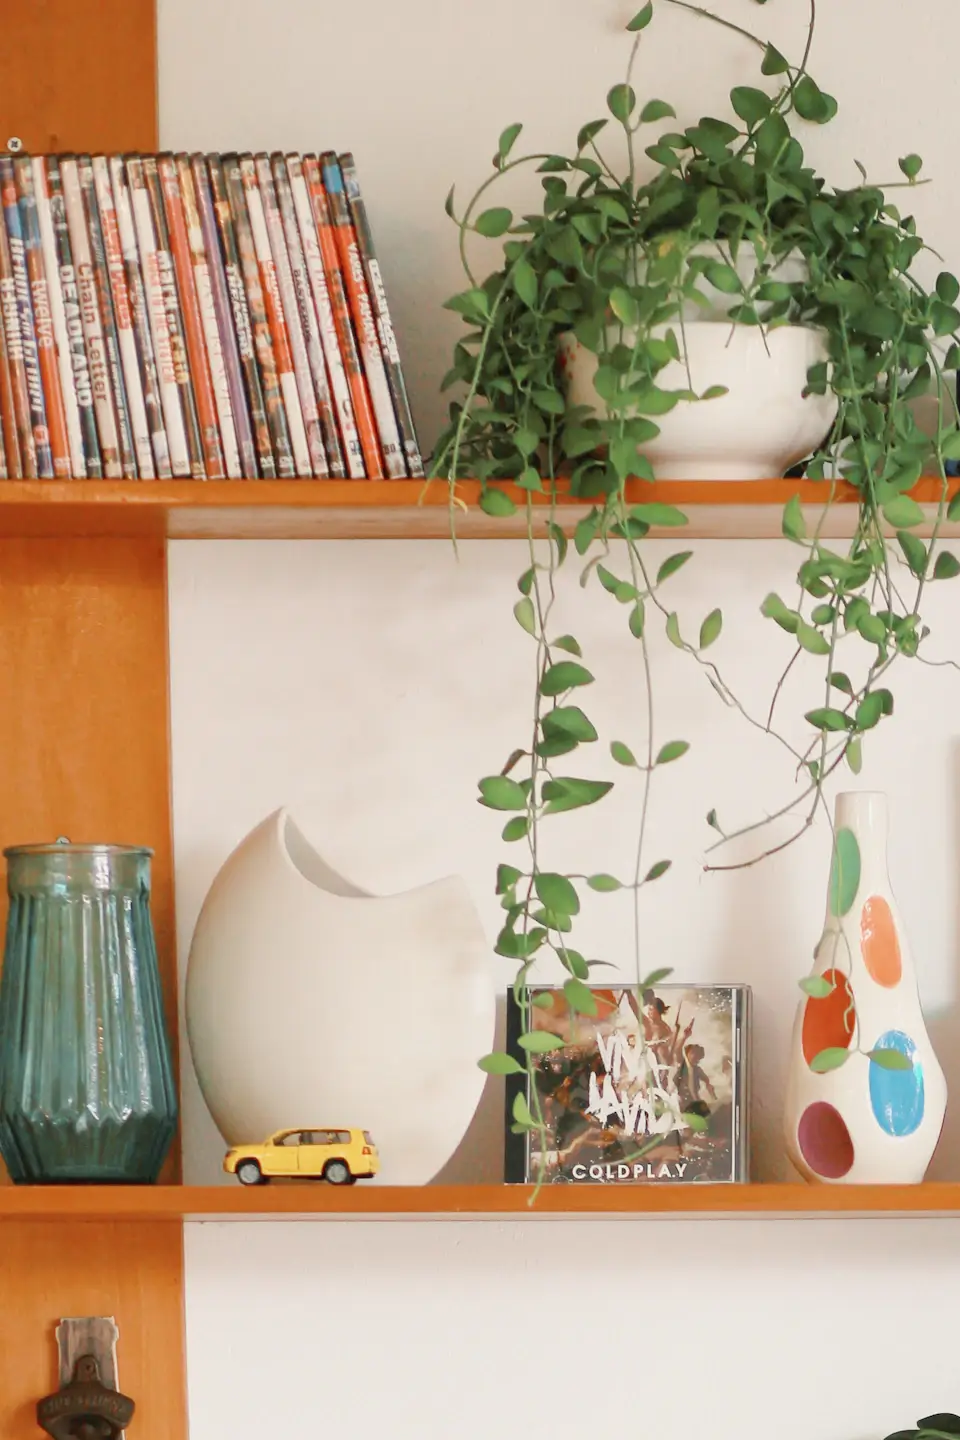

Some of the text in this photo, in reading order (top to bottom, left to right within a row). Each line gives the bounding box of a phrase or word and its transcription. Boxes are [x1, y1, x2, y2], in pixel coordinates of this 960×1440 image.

[31, 280, 52, 349] twelve
[59, 264, 91, 408] DEADLAND
[77, 262, 97, 325] Chain
[90, 334, 108, 402] Letter
[572, 1163, 688, 1179] COLDPLAY
